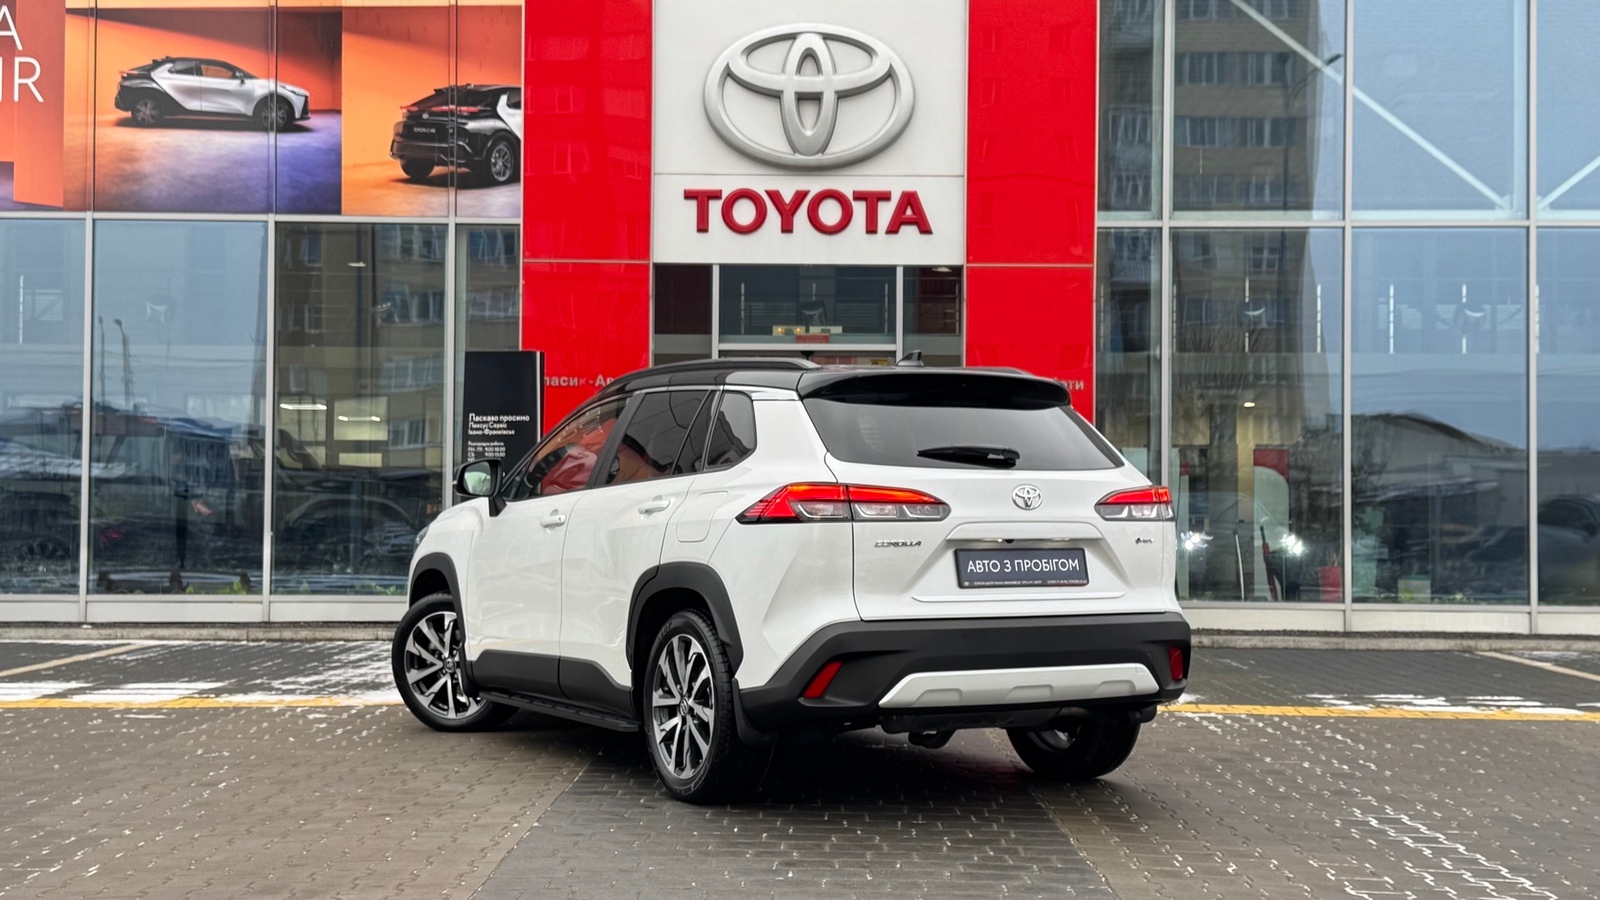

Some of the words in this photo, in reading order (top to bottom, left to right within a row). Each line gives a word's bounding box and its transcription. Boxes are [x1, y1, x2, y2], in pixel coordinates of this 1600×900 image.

[683, 188, 934, 236] TOYOTA
[499, 415, 530, 423] просимо
[873, 539, 923, 548] COROLLA
[966, 560, 1001, 573] АВТО
[1014, 558, 1080, 572] ПРОБІГОМ
